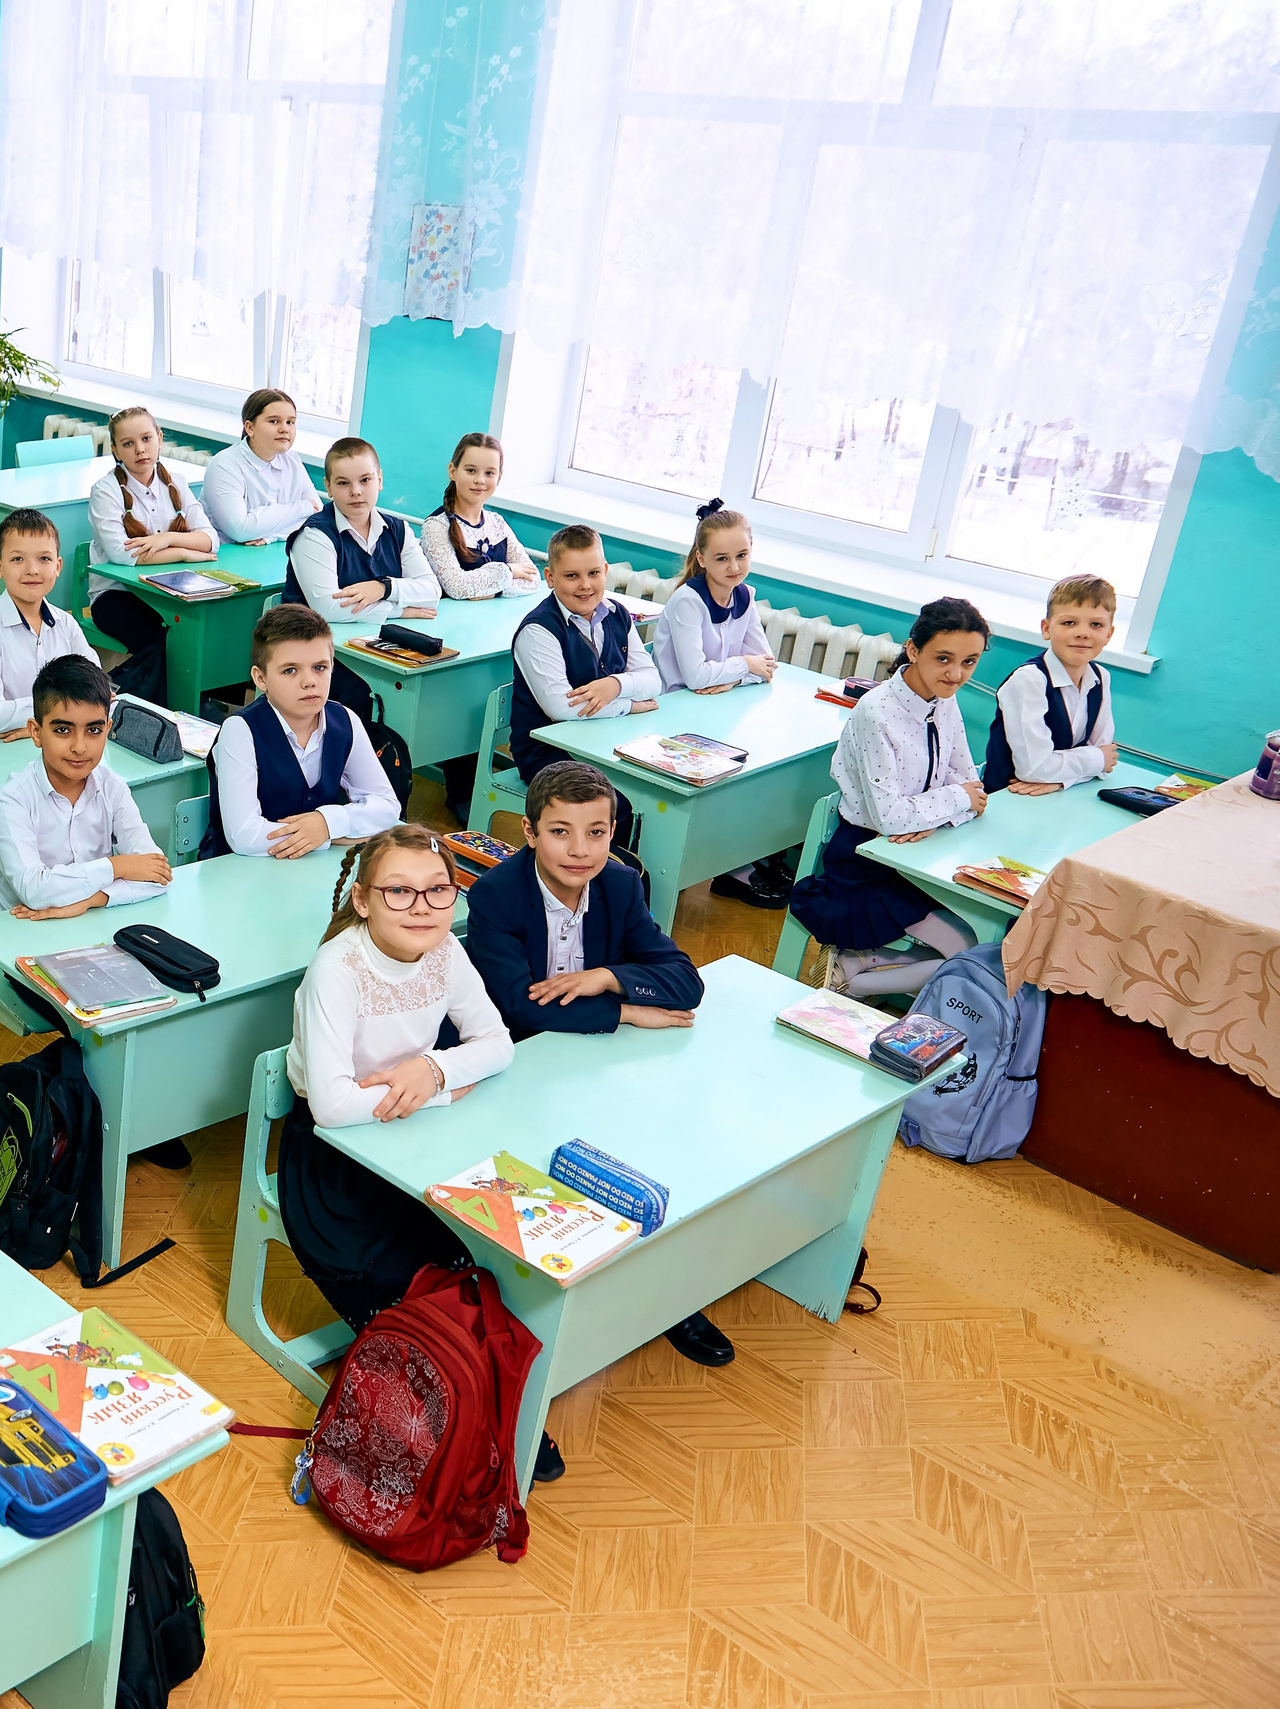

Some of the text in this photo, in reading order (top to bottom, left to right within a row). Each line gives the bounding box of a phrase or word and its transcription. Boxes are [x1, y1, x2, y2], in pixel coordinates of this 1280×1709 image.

[946, 997, 984, 1024] SPORT
[558, 1155, 567, 1165] NOT
[568, 1160, 577, 1170] DO
[555, 1162, 566, 1173] NOT
[566, 1169, 575, 1178] DO
[577, 1166, 597, 1183] PANIC
[564, 1177, 574, 1186] DO
[575, 1176, 595, 1192] PANIC
[598, 1180, 611, 1190] NOT
[574, 1183, 594, 1198] PANIC
[595, 1188, 608, 1198] NOT
[594, 1194, 607, 1206] NOT
[609, 1194, 618, 1203] DO
[607, 1201, 617, 1210] DO
[446, 1194, 500, 1232] 4
[523, 1213, 565, 1241] язык
[550, 1209, 607, 1241] Русский
[6, 1363, 60, 1413] 4
[86, 1391, 142, 1425] язык
[120, 1385, 194, 1426] Русский
